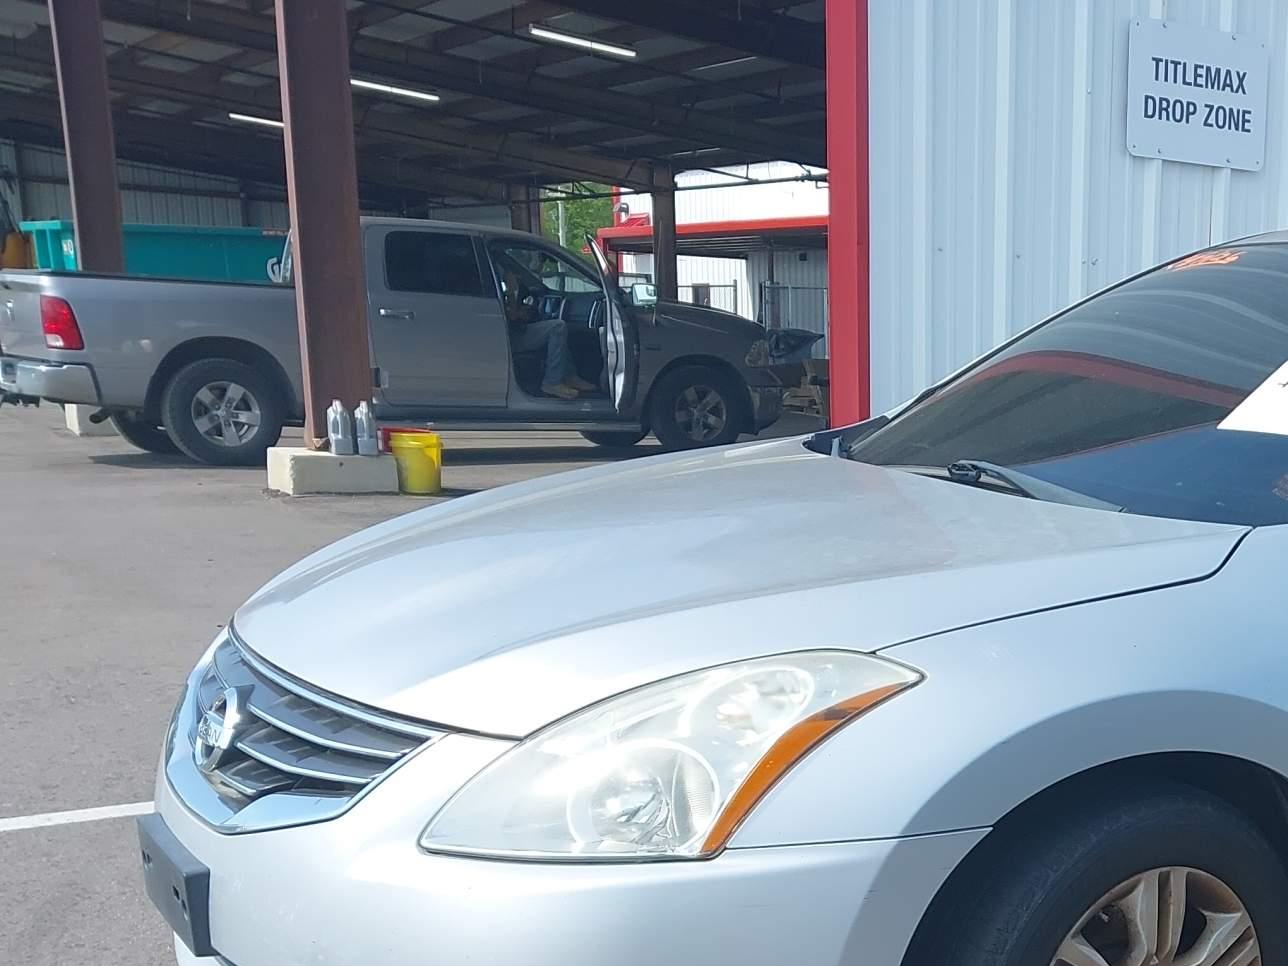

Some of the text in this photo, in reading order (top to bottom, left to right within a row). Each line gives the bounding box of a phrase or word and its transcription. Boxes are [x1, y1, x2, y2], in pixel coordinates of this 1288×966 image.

[1151, 56, 1248, 95] TITLEMAX
[1143, 95, 1252, 133] DROP ZONE
